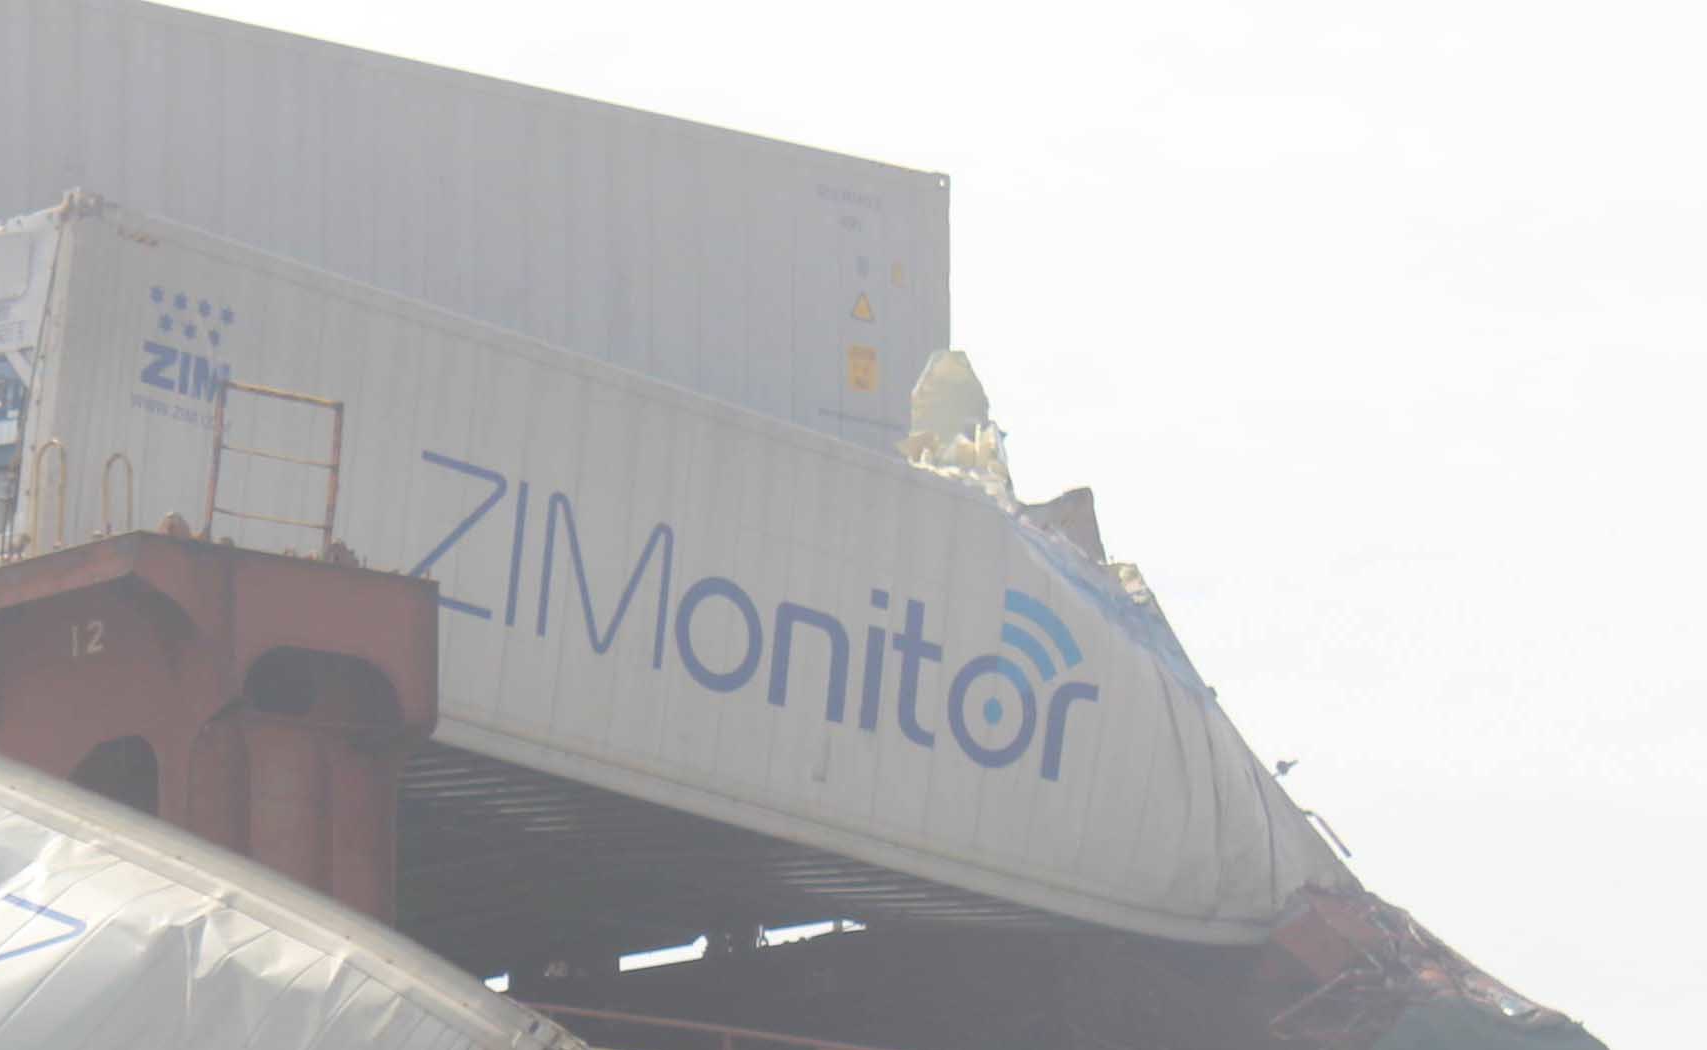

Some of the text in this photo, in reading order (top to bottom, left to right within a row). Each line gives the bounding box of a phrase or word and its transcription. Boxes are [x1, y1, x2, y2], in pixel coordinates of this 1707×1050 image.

[140, 339, 231, 404] ZIM
[71, 620, 105, 657] 12
[409, 450, 1099, 781] ZIMonitor
